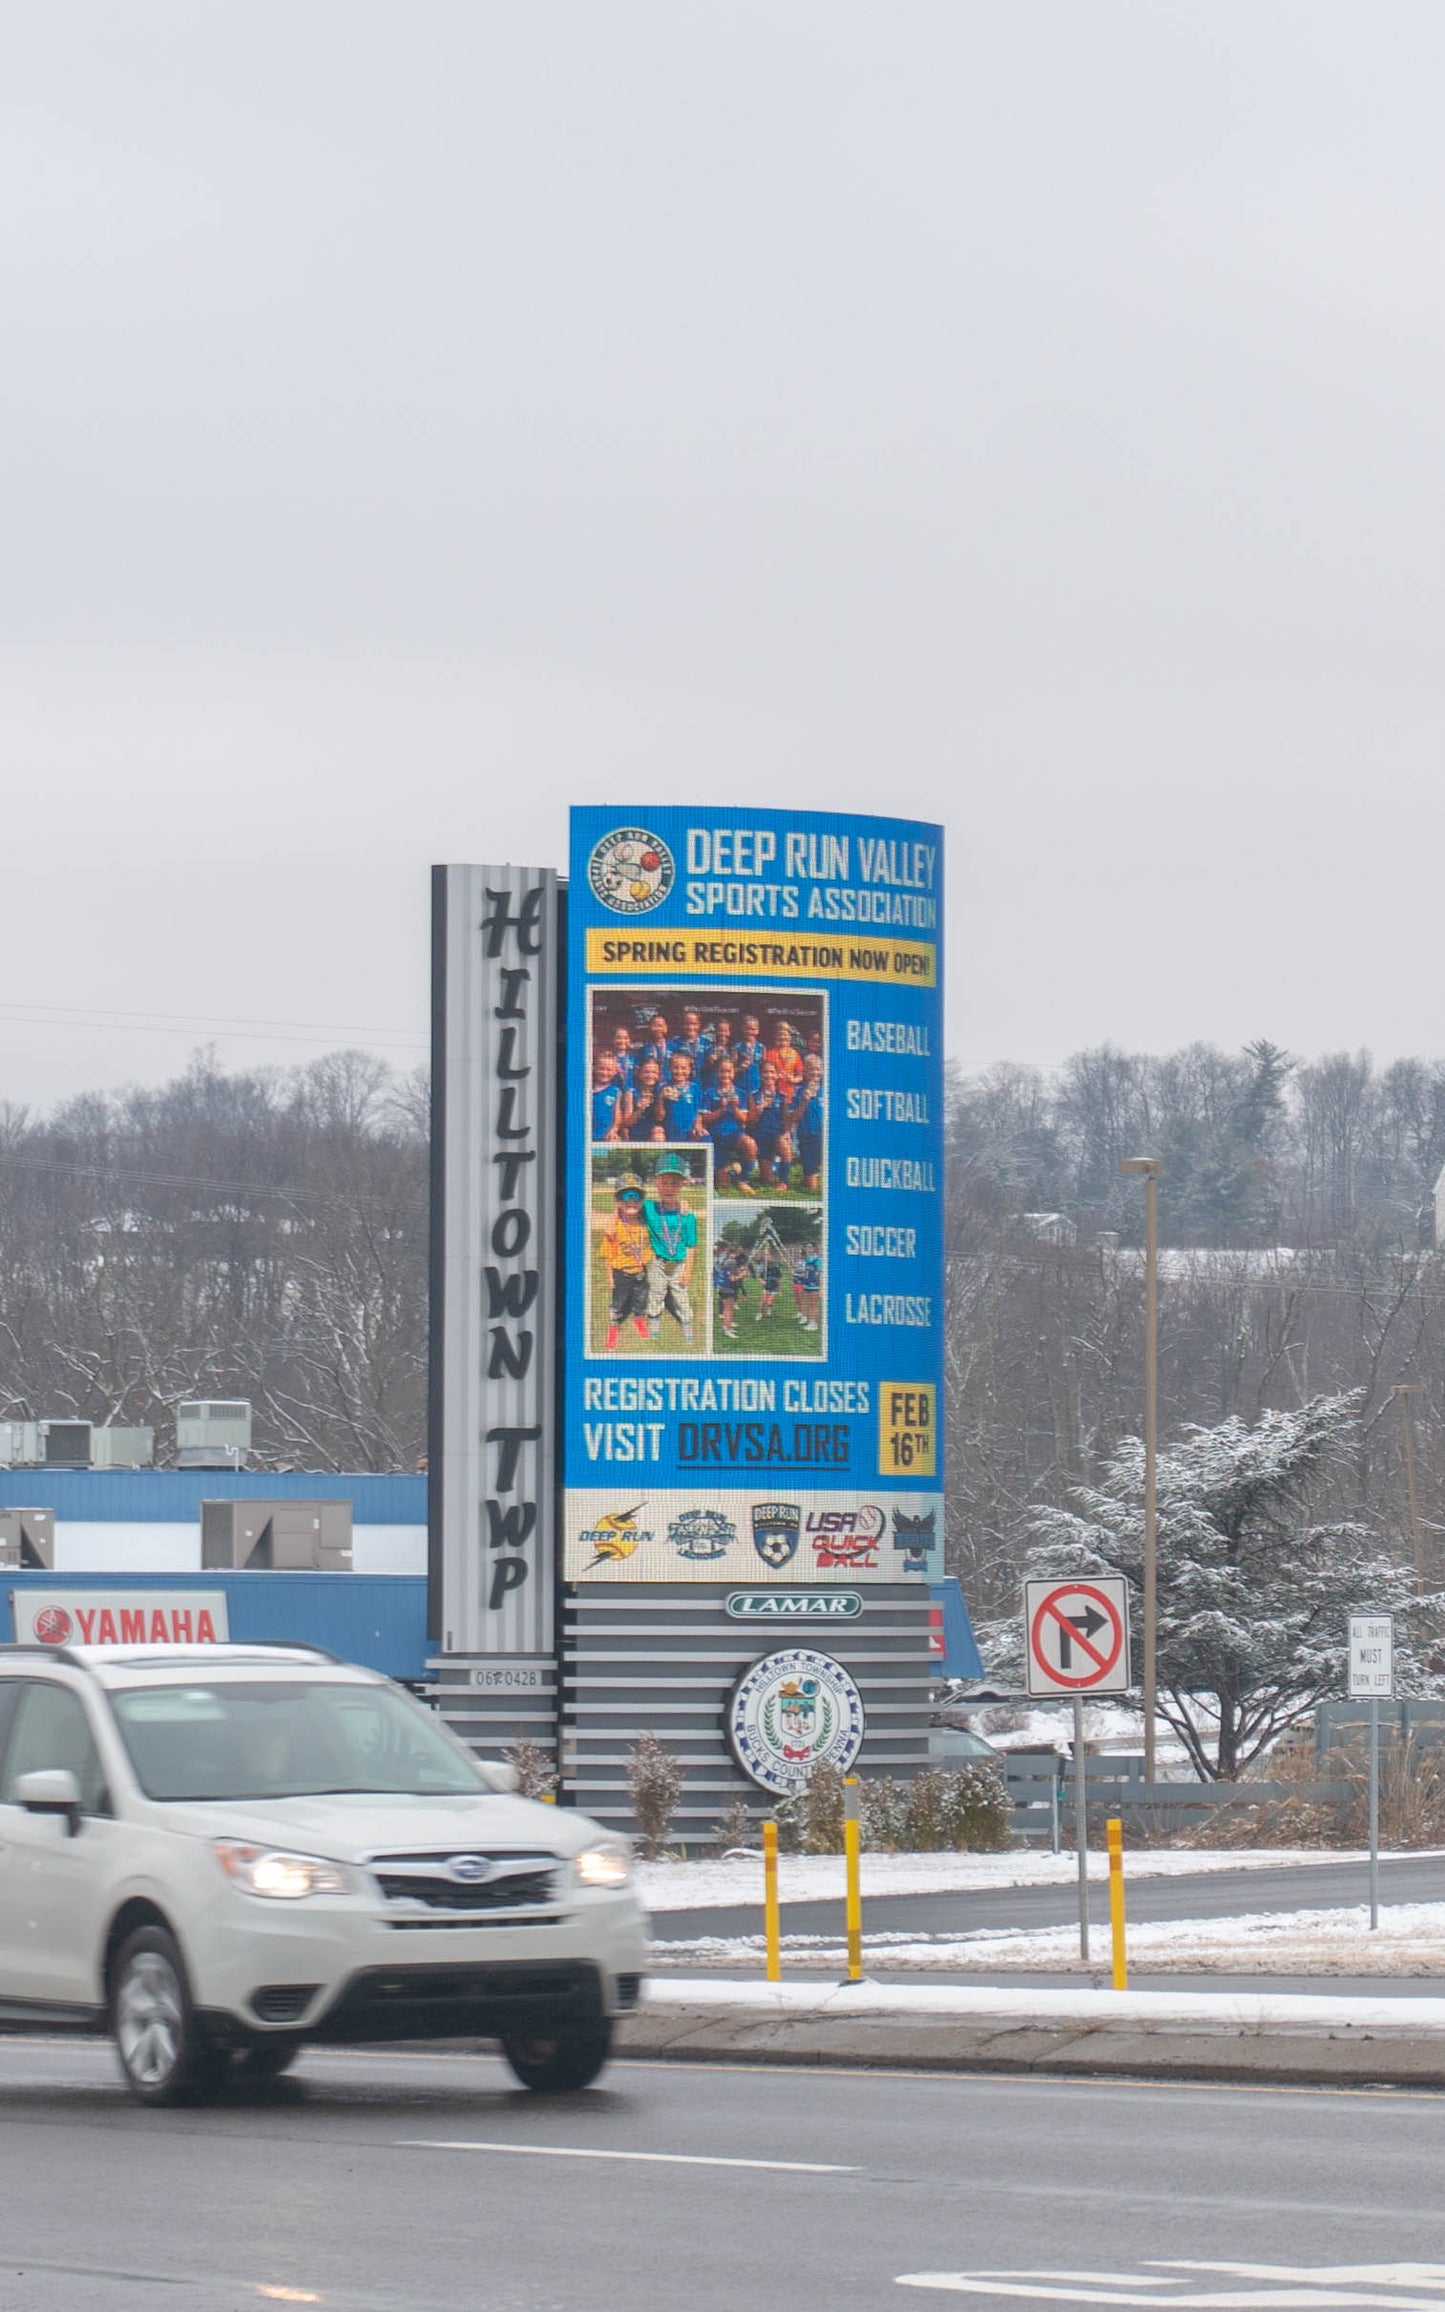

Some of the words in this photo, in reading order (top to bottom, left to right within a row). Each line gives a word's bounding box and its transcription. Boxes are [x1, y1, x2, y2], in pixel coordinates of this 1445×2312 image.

[687, 829, 776, 876] DEEP
[786, 832, 850, 880] RUN
[857, 837, 936, 890] VALLEY
[687, 882, 799, 919] SPORTS
[808, 888, 937, 929] ASSOCIATION
[603, 941, 686, 964] SPRING
[694, 943, 843, 970] REGISTRATION
[849, 949, 890, 971] NOW
[846, 1020, 931, 1057] BASEBALL
[846, 1088, 931, 1125] SOFTBALL
[480, 887, 548, 1380] HILLTOWN
[845, 1157, 937, 1193] QUICKBALL
[845, 1225, 917, 1259] SOCCER
[845, 1293, 933, 1328] LACROSSE
[583, 1377, 776, 1412] REGISTRATION
[784, 1380, 871, 1415] CLOSES
[890, 1392, 931, 1428] FEB
[583, 1422, 666, 1462] VISIT
[679, 1423, 851, 1463] DRVSA.ORG
[890, 1432, 931, 1466] 16TH
[485, 1424, 543, 1611] TWP
[754, 1505, 779, 1521] DEEP
[779, 1505, 800, 1521] RUN
[805, 1512, 858, 1533] USA
[579, 1530, 617, 1542] DEEP
[621, 1530, 656, 1542] RUN
[812, 1534, 881, 1551] QUICK
[741, 1597, 848, 1614] LAMAR
[75, 1608, 217, 1644] YAMAHA
[1360, 1648, 1382, 1664] MUST
[754, 1662, 797, 1693] HILLTOWN
[800, 1662, 844, 1695] TOWNSHIP
[1352, 1673, 1370, 1686] TURN
[1374, 1673, 1390, 1686] LEFT
[746, 1723, 772, 1762] BUCKS
[770, 1759, 815, 1777] COUNT
